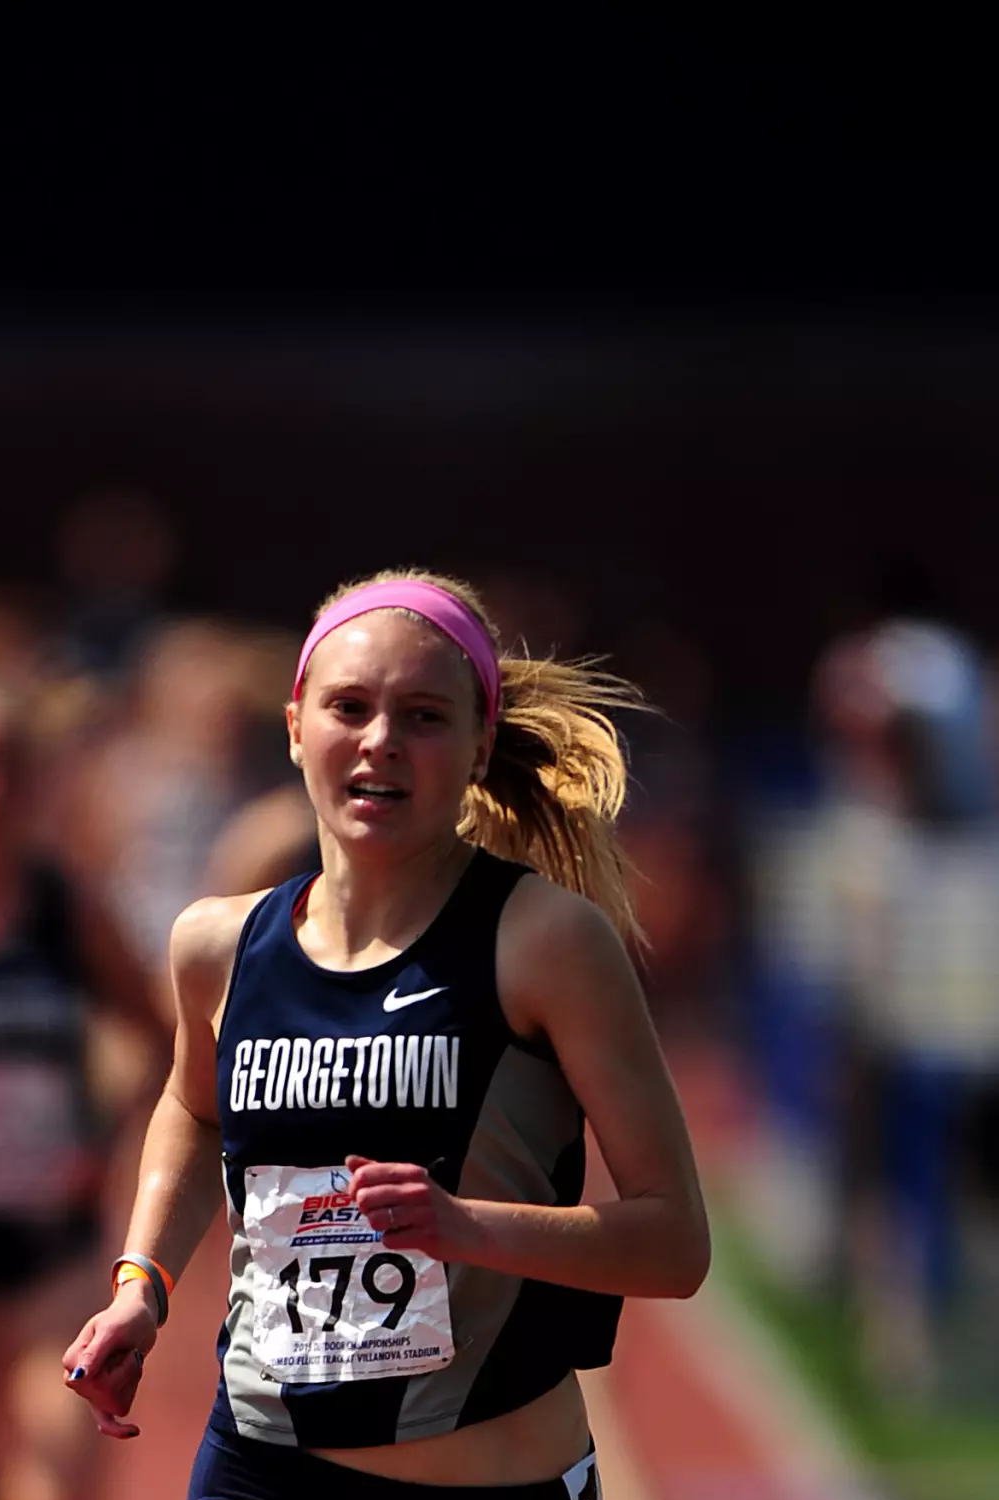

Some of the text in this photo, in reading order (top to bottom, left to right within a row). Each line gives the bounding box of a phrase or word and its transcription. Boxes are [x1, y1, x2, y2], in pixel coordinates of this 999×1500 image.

[230, 1035, 460, 1112] GEORGETOWN
[303, 1193, 352, 1209] BIG
[279, 1252, 416, 1333] 179
[357, 1350, 402, 1362] VILLANOVA
[404, 1346, 441, 1359] STADIUM
